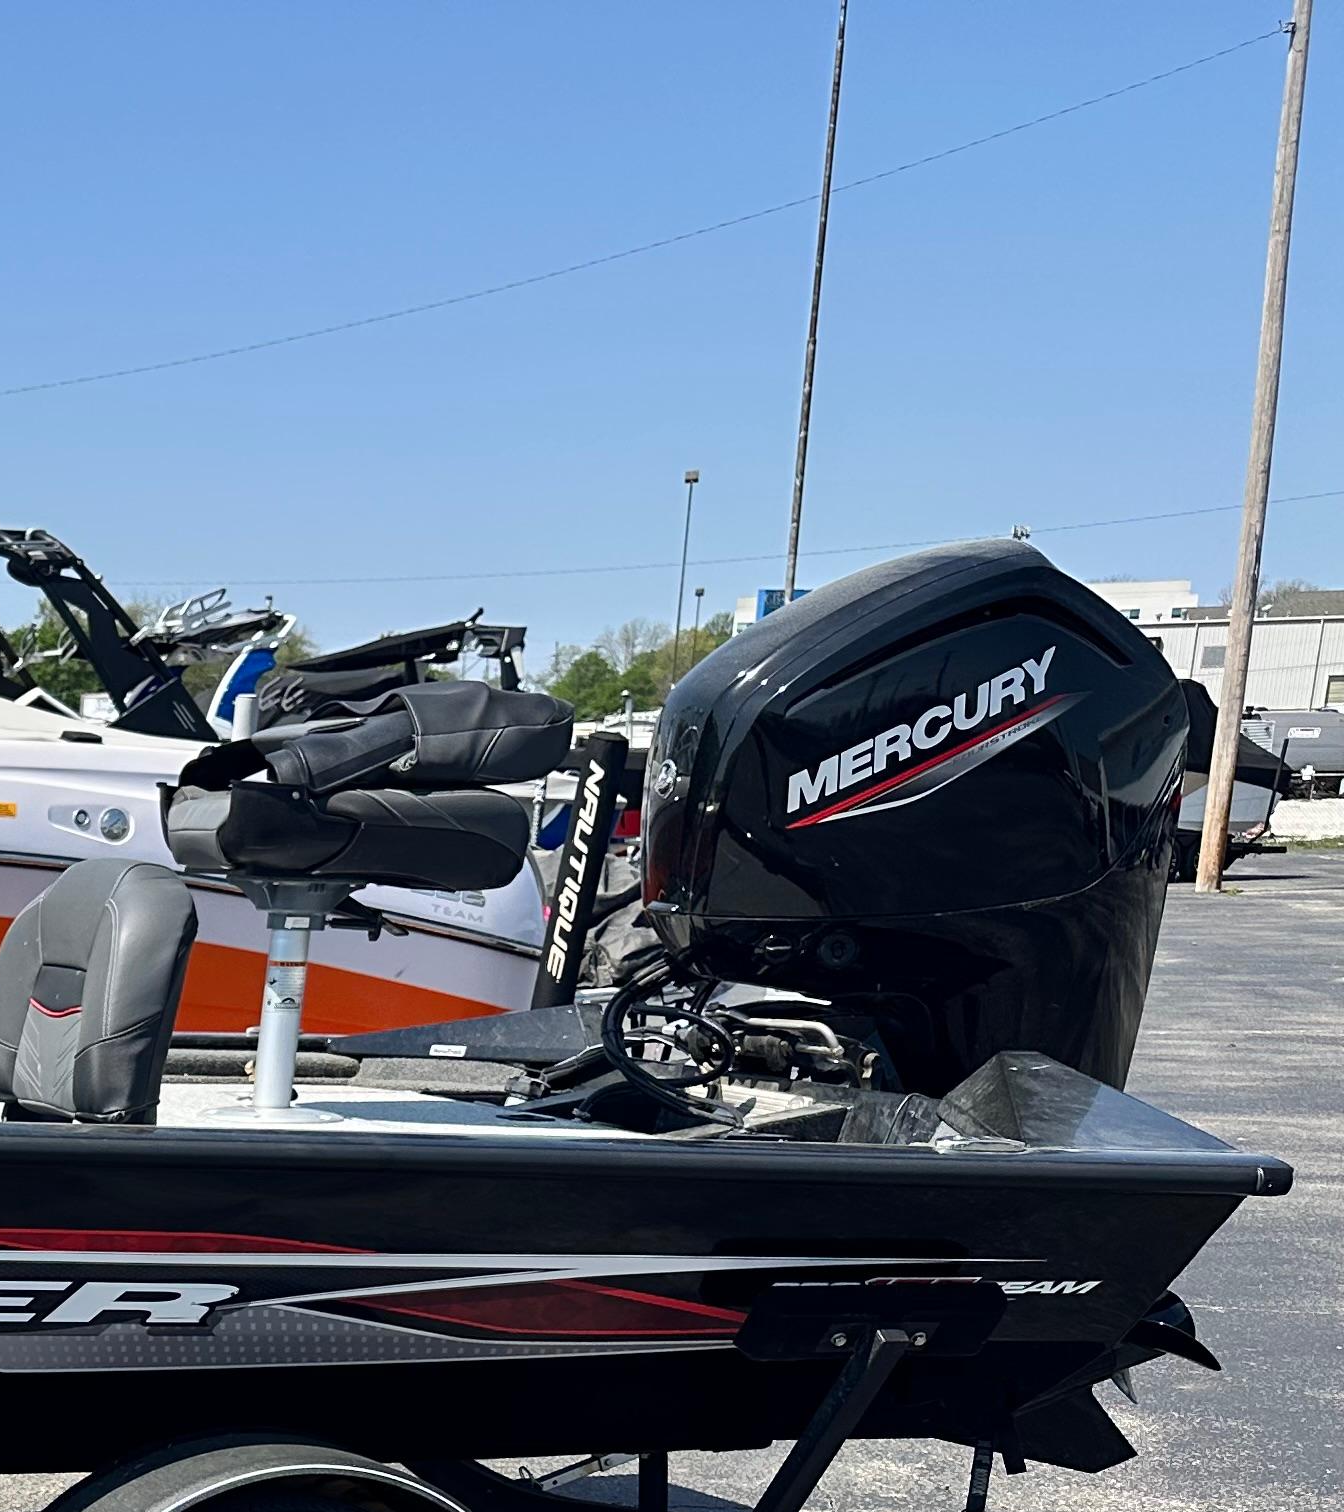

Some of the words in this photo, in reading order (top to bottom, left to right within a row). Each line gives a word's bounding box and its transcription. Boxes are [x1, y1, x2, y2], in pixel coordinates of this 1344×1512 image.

[786, 645, 1057, 814] MERCURY
[432, 903, 484, 924] TEAM
[546, 758, 606, 982] NAUTIQUE
[996, 1280, 1103, 1294] EAM
